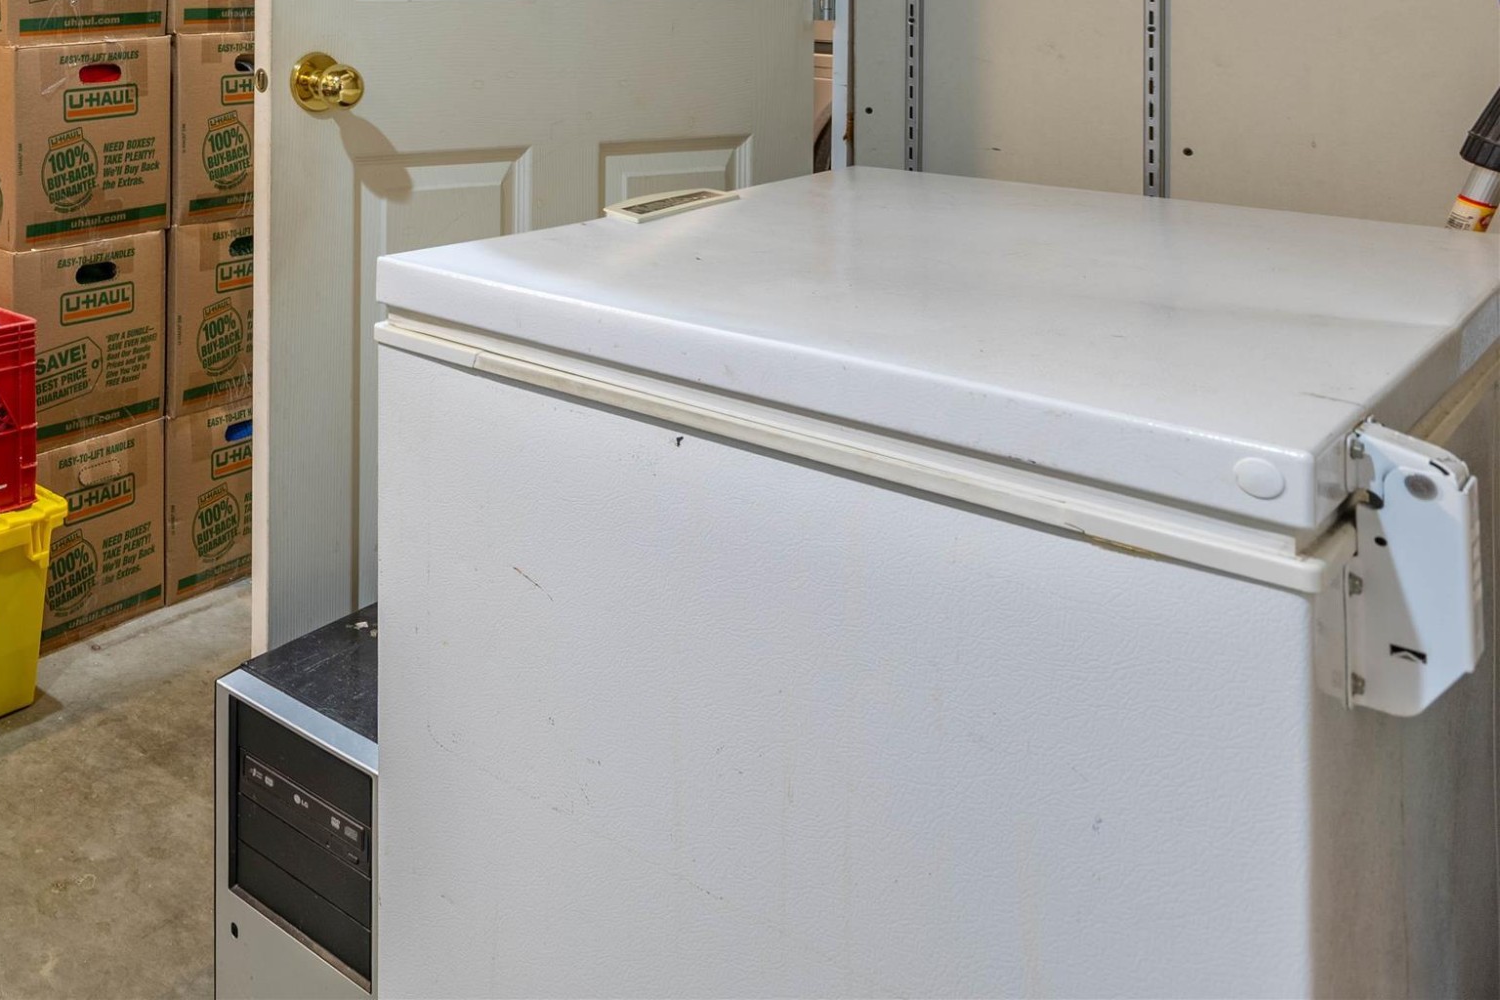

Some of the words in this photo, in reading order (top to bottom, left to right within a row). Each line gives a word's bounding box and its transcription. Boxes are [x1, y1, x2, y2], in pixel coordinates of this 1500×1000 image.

[64, 16, 120, 27] uhaul.com
[60, 53, 105, 65] EASY-TO-LIFT
[108, 51, 139, 61] HANDLES
[69, 93, 133, 109] U-HAUL
[48, 144, 89, 174] 100%
[47, 164, 95, 190] BUY-BACK
[50, 178, 97, 204] GUARANTEE
[71, 212, 126, 229] uhaul.com
[66, 289, 129, 312] U-HAUL
[36, 344, 87, 376] SAVE!
[36, 377, 60, 394] BEST
[61, 368, 87, 386] PRICE
[68, 480, 131, 512] U-HAUL
[198, 497, 233, 530] 100%
[196, 513, 237, 546] BUY-BACK
[198, 527, 238, 557] GUARANTEE
[50, 545, 89, 581] 100%
[48, 566, 95, 599] BUY-BACK
[49, 579, 96, 611] GUARANTEE
